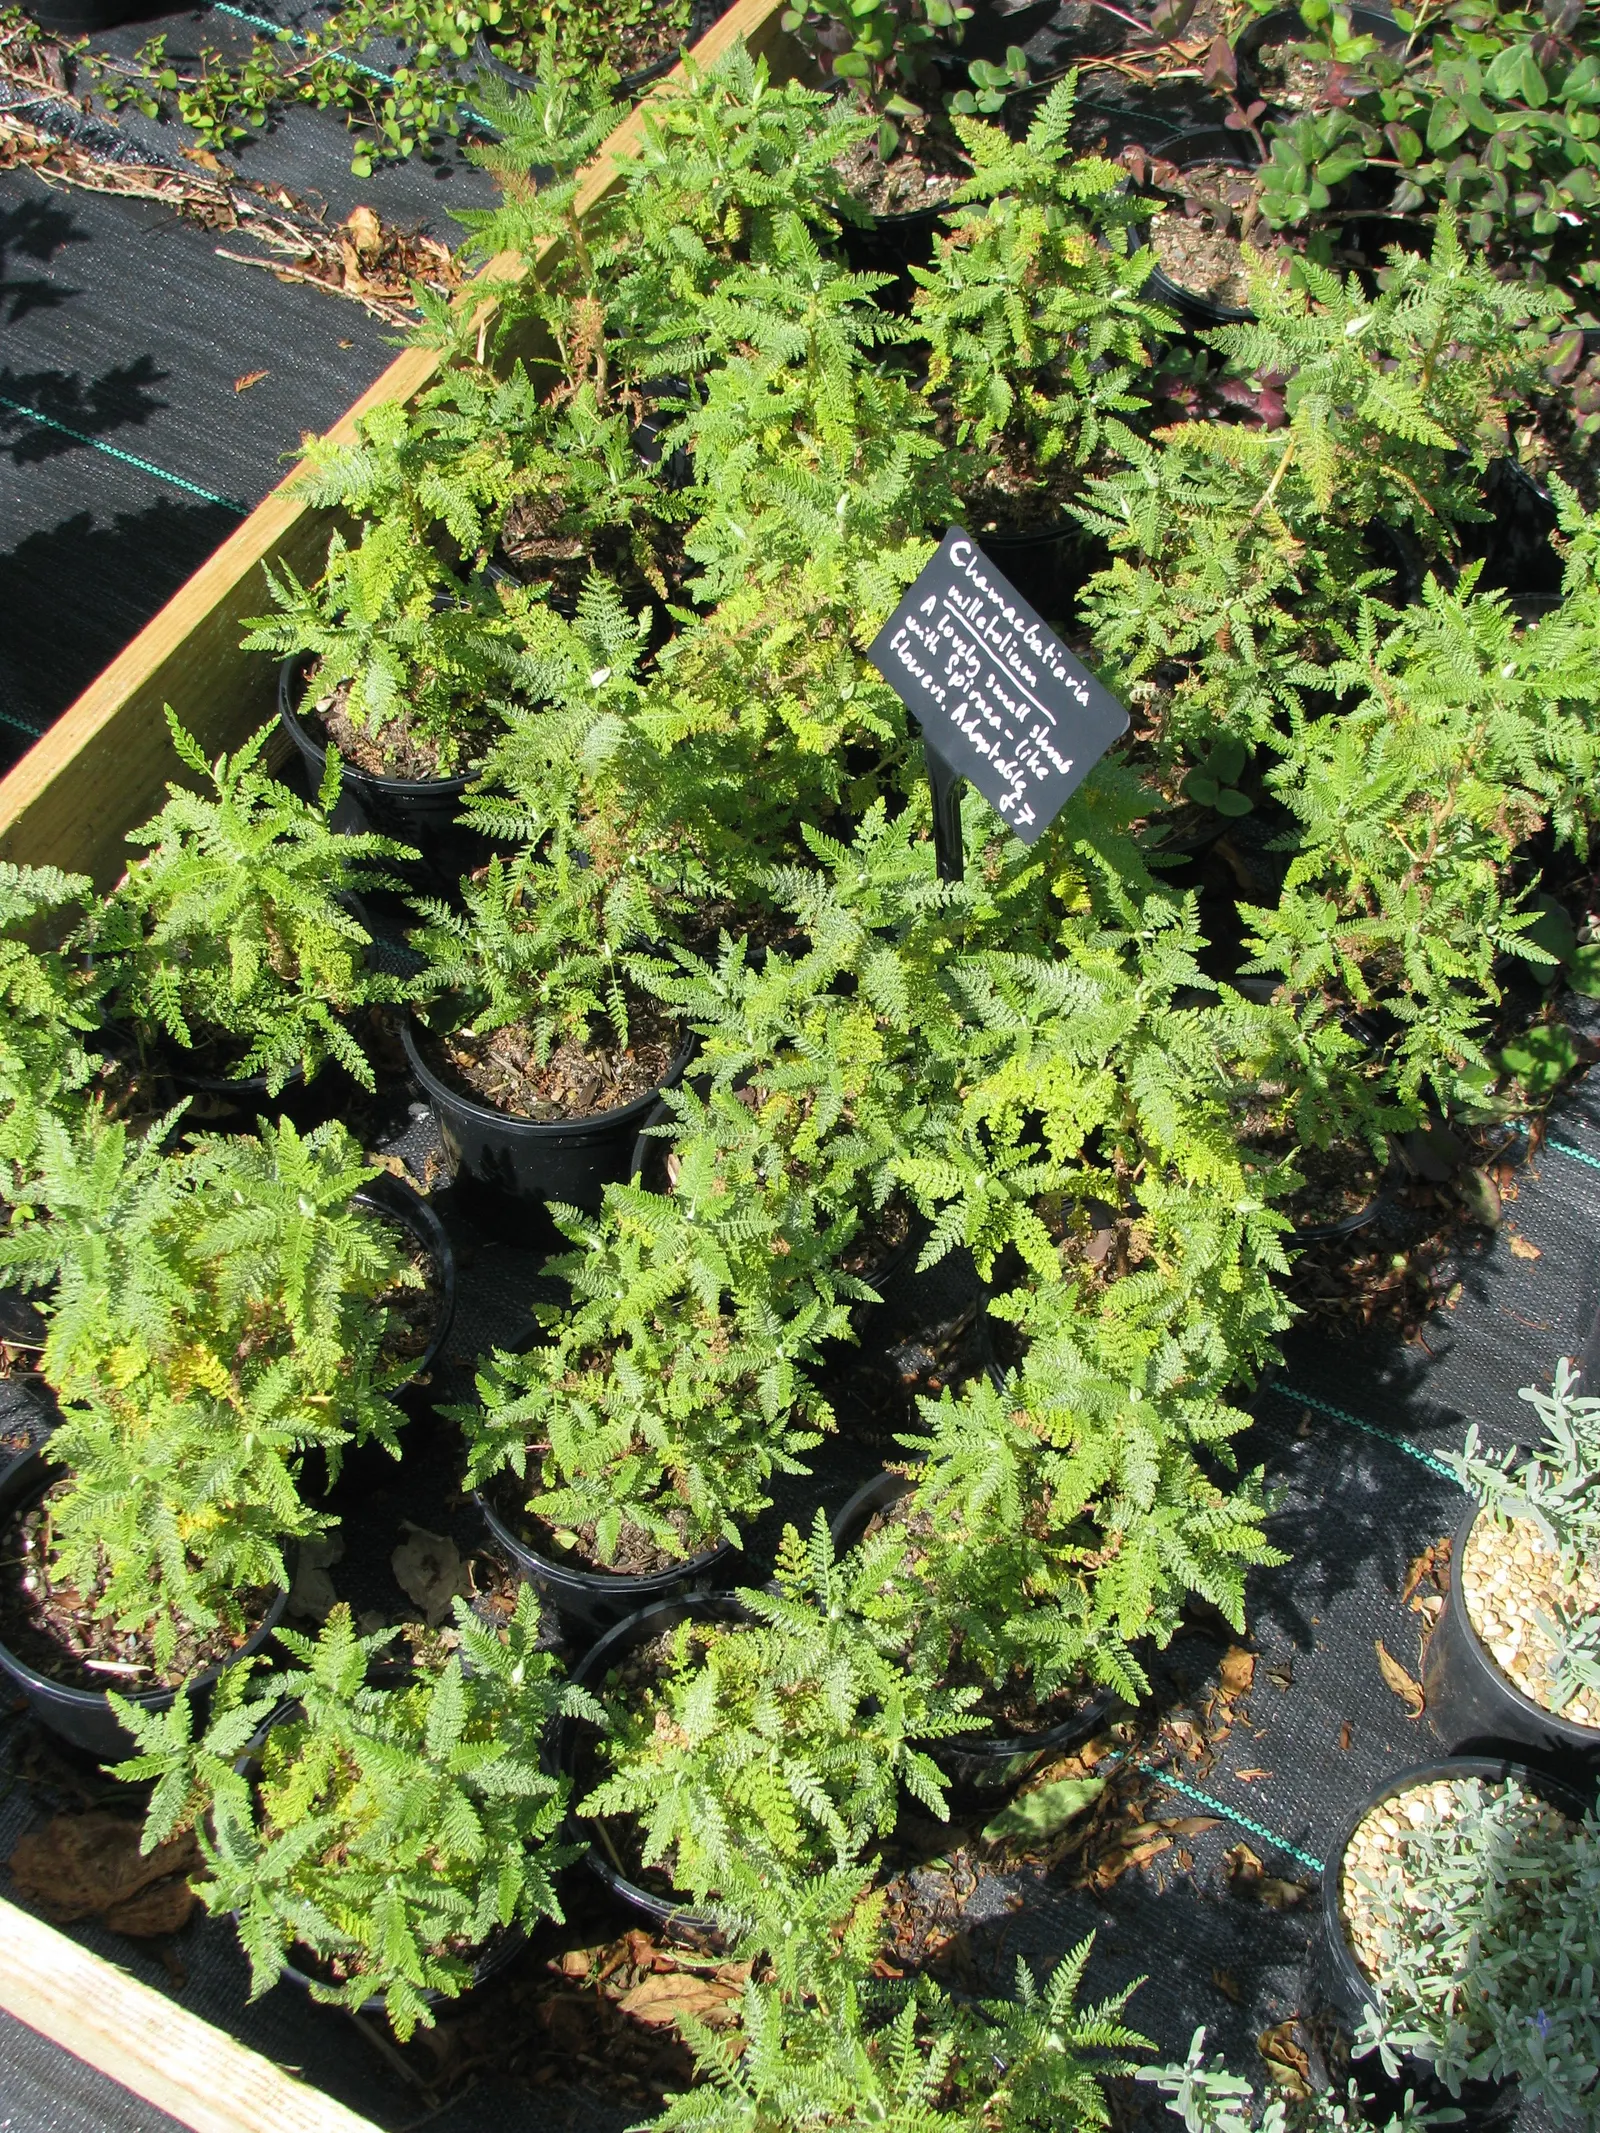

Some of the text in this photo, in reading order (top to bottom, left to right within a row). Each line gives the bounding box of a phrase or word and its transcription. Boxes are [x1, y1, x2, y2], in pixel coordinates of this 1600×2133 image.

[905, 616, 939, 655] with
[948, 585, 1037, 687] millefolium
[949, 541, 1090, 707] Chamaebatiaria
[920, 595, 1074, 774] A lovely small shrub
[951, 703, 1026, 792] Adaptable
